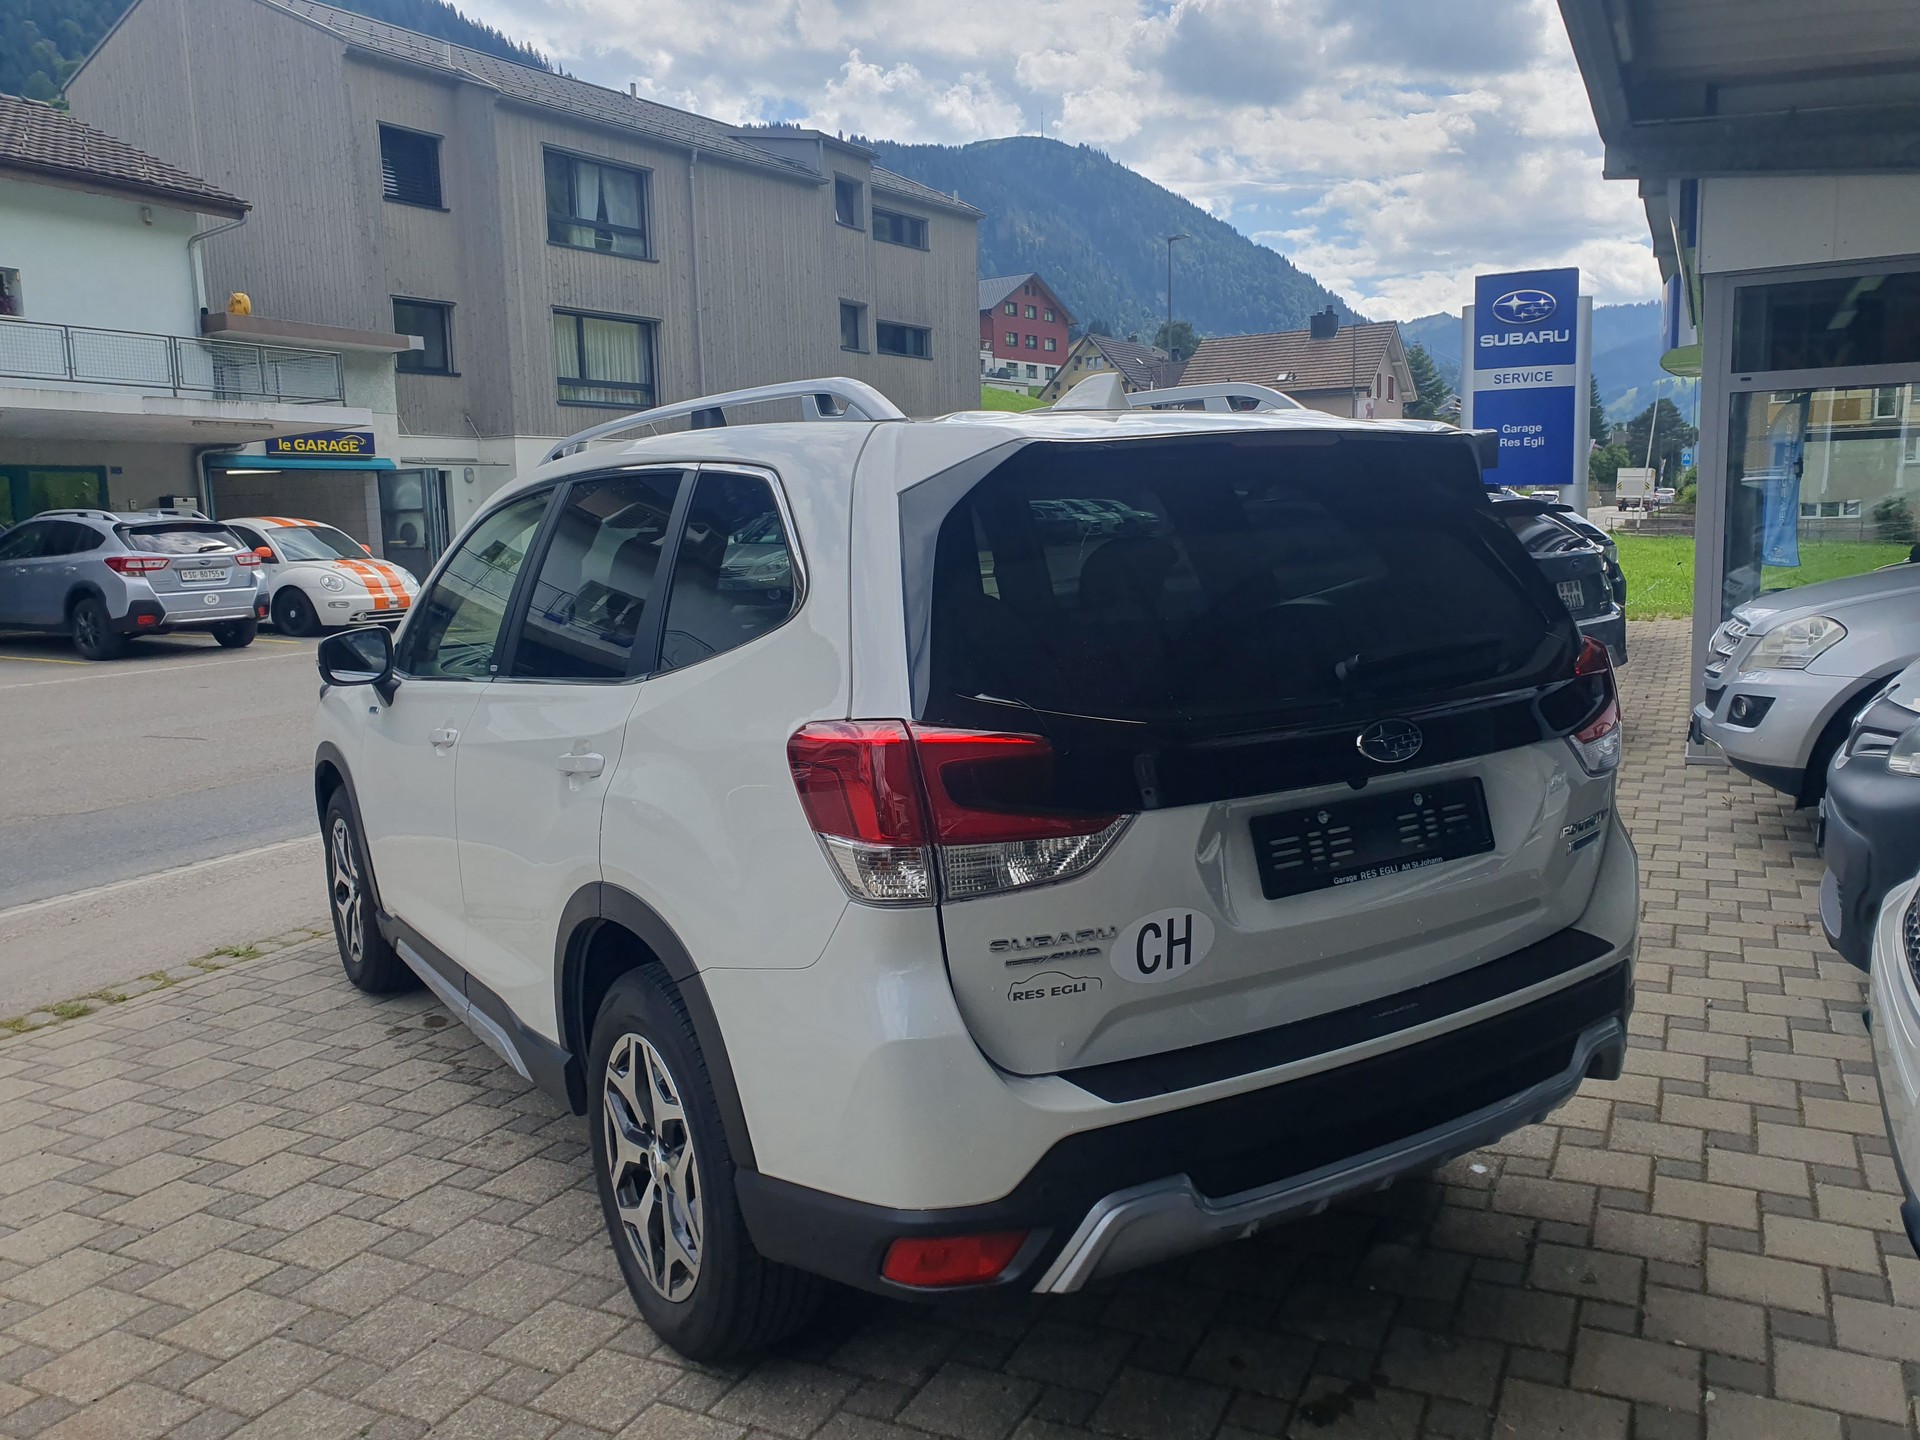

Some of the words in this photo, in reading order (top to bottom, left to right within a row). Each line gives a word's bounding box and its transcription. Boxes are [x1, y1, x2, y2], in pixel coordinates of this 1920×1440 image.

[1480, 329, 1570, 348] SUBARU
[1493, 371, 1553, 384] SERVICE
[1502, 424, 1543, 435] Garage
[278, 438, 291, 451] le
[293, 439, 360, 453] GARAGE
[1500, 437, 1520, 447] Res
[1523, 437, 1545, 448] Egli
[206, 595, 217, 604] CH
[1333, 874, 1358, 885] Garage
[1360, 869, 1378, 880] RES
[1380, 864, 1398, 876] EGLI
[990, 925, 1119, 953] SUBARU
[1136, 913, 1193, 975] CH
[1012, 988, 1045, 1001] RES
[1050, 982, 1087, 997] EGLI
